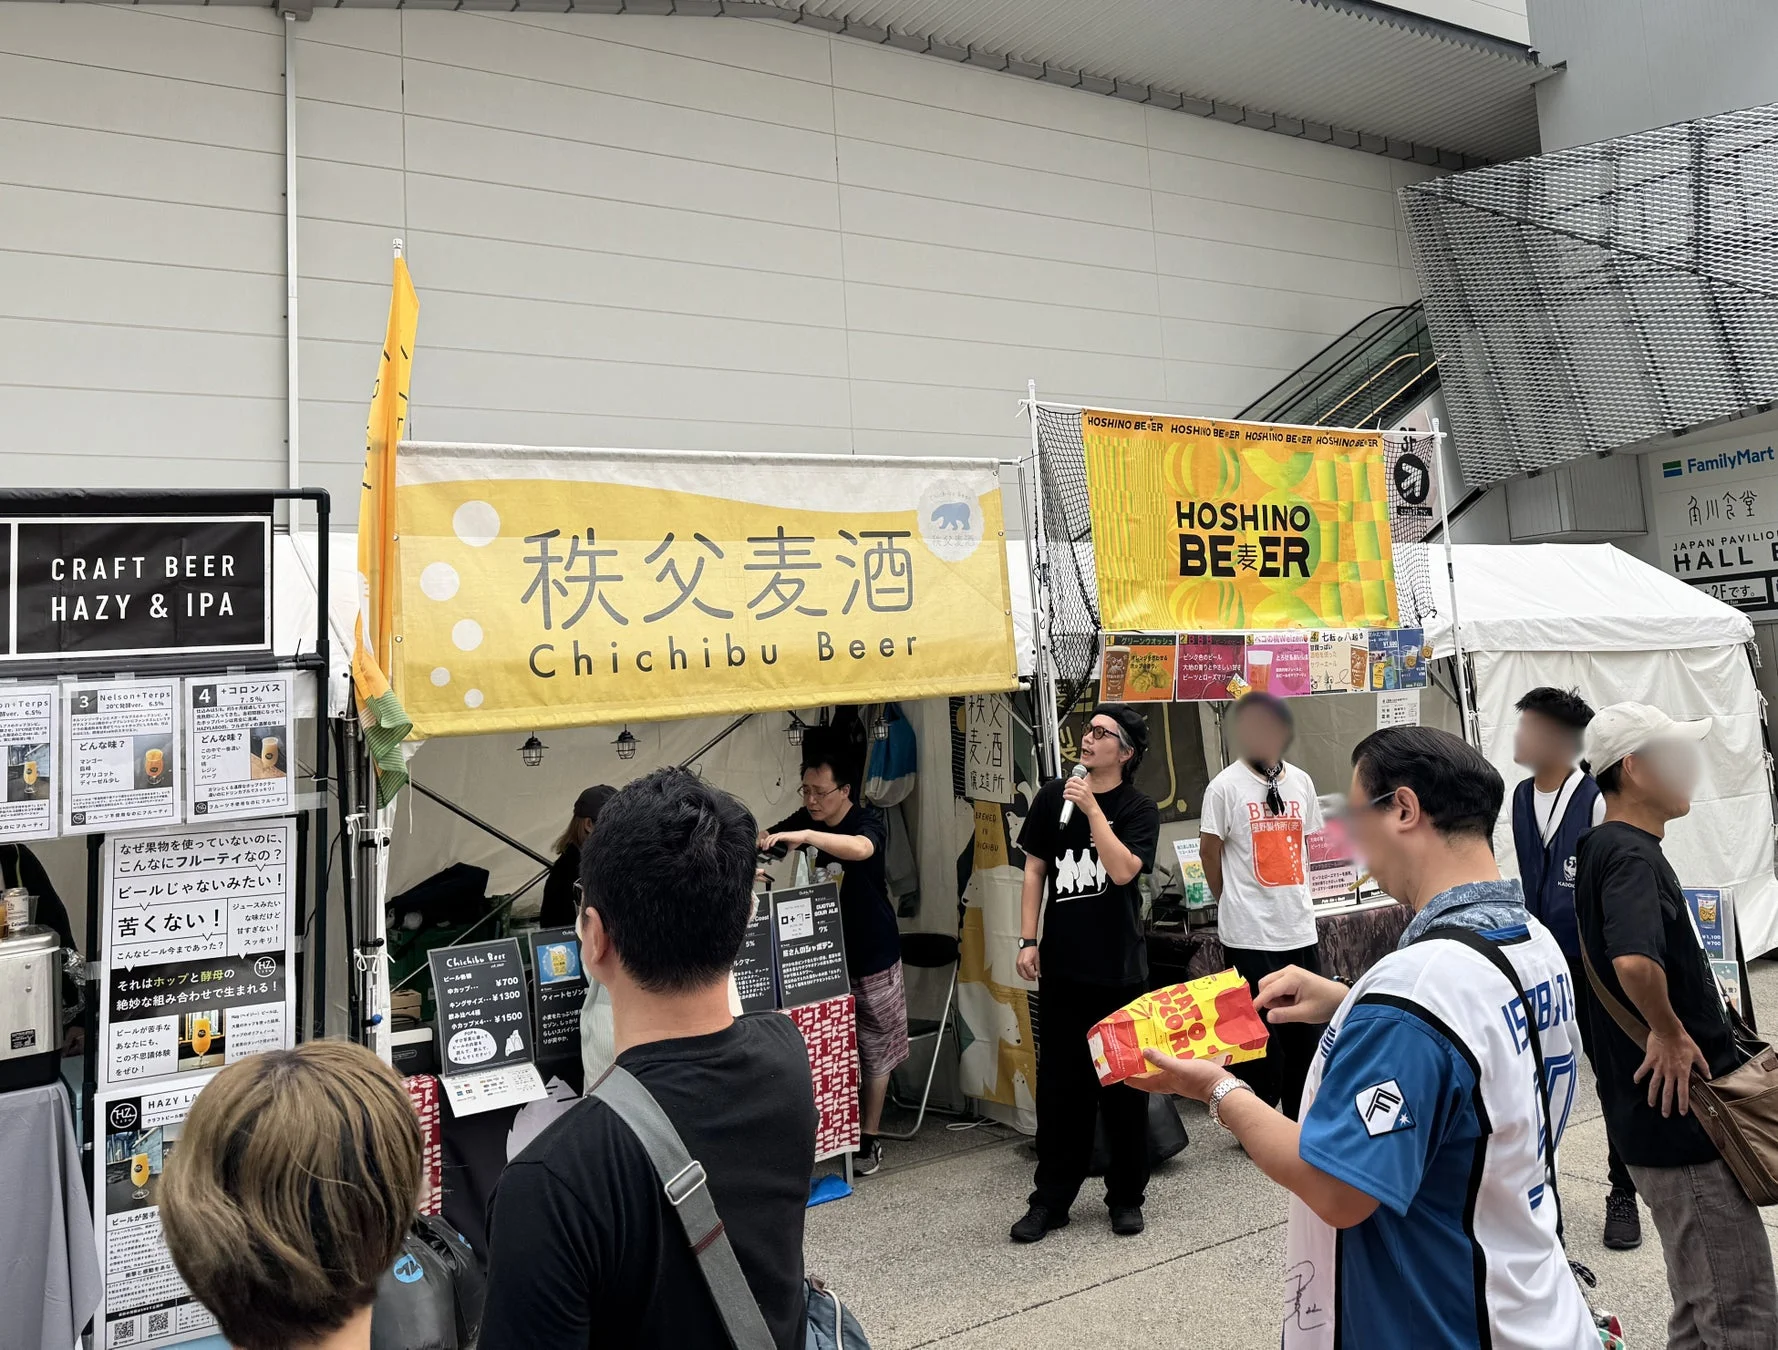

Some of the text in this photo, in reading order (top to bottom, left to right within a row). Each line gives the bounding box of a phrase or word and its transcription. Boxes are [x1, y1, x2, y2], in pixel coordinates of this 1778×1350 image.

[1088, 416, 1132, 430] HOSHINO
[1170, 423, 1211, 437] HOSHINO
[1245, 431, 1284, 443] HOSHINO
[1316, 436, 1355, 448] HOSHINO
[1687, 446, 1775, 474] FamilyMart
[1687, 489, 1757, 526] 角川食堂
[1176, 501, 1311, 532] HOSHINO
[1673, 530, 1778, 551] JAPAN PAVILIO
[1673, 546, 1754, 573] HALL
[51, 555, 235, 581] CRAFT BEER
[520, 525, 913, 631] 秩父麦酒
[1704, 584, 1755, 599] 2Fです。
[51, 592, 234, 621] HAZY & IPA
[528, 630, 918, 679] Chichibu Beer
[80, 695, 89, 708] 3
[199, 688, 210, 704] 4
[80, 740, 125, 751] どんな味？
[201, 733, 242, 744] どんな味？
[120, 833, 283, 855] なぜ果物を使っていないのに、
[119, 849, 283, 873] こんなにフルーティなの？
[119, 873, 282, 900] ビールじゃないみたい！
[232, 900, 281, 911] ジュースみたい
[118, 908, 220, 938] 苦くない！
[245, 911, 281, 922] な味だけど
[237, 923, 279, 935] 甘すぎない！
[244, 935, 279, 946] スッキリ！
[116, 941, 224, 961] こんなビール今まであった？
[446, 955, 485, 968] Chichibu
[487, 952, 506, 960] Beer
[117, 968, 235, 992] それはホップと酵母の
[495, 977, 519, 987] ¥700
[116, 980, 277, 1011] 絶妙な組み合わせで生まれる！
[492, 990, 520, 1002] ¥1300
[494, 1011, 523, 1023] ¥1500
[116, 1023, 171, 1037] ビールが苦手な
[115, 1038, 159, 1050] あなたにも、
[115, 1049, 171, 1064] この不思議体験
[115, 1065, 145, 1077] をぜひ！
[148, 1093, 197, 1109] HAZY LA
